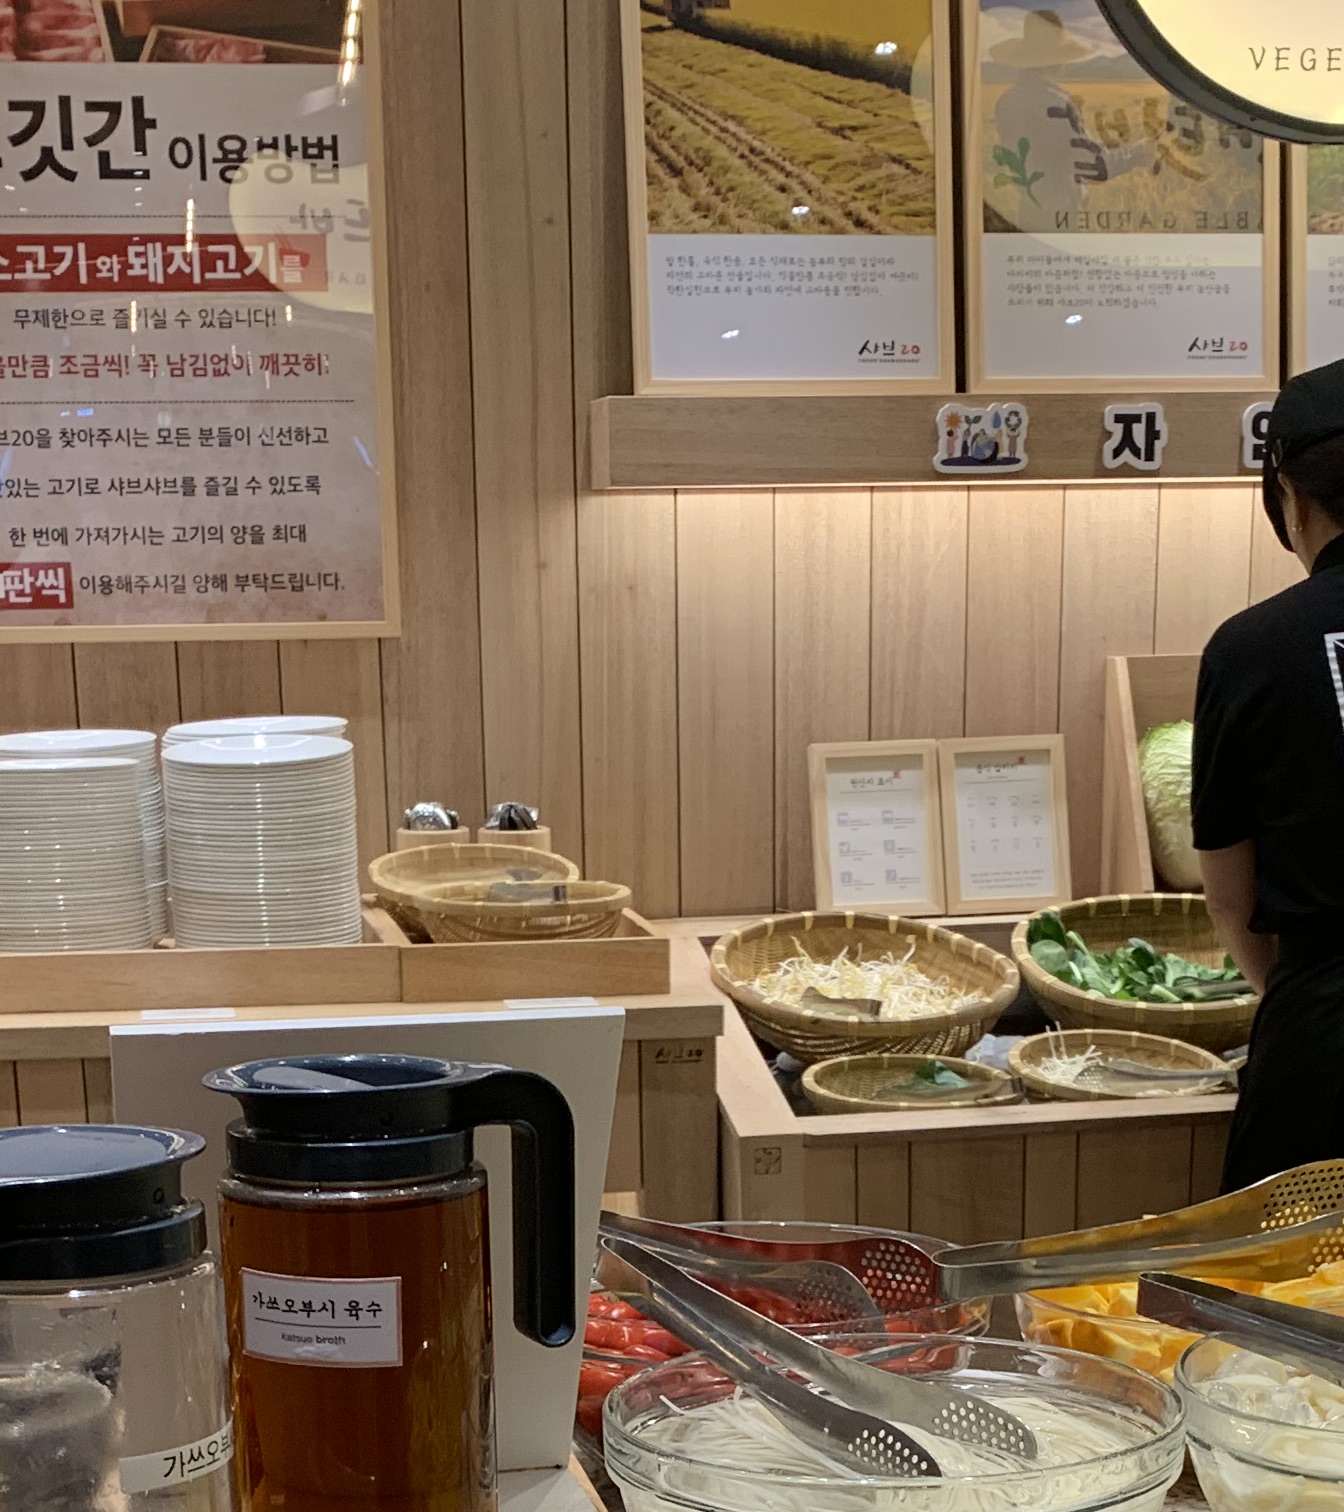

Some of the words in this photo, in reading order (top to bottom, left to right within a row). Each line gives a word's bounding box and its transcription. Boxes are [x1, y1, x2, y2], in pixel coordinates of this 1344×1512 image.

[167, 132, 342, 186] 이용방법
[126, 240, 307, 286] 돼지고기를
[12, 308, 107, 330] 무제한으로
[173, 309, 193, 330] 수
[198, 307, 277, 330] 있습니다!
[58, 354, 131, 380] 조금씩!
[137, 353, 159, 379] 꼭
[166, 352, 253, 378] 남김없이
[58, 428, 149, 450] 찾아주시는
[155, 427, 192, 449] 모든
[197, 426, 252, 449] 분들이
[257, 424, 330, 448] 신선하고
[46, 476, 101, 499] 고기로
[107, 476, 197, 499] 샤브샤브를
[203, 475, 239, 497] 즐길
[243, 475, 264, 497] 수
[268, 473, 323, 497] 있도록
[8, 526, 26, 549] 한
[32, 525, 69, 548] 번에
[74, 524, 165, 548] 가져가시는
[171, 523, 225, 546] 고기의
[230, 523, 266, 547] 양을
[271, 522, 308, 545] 최대
[78, 572, 188, 596] 이용해주시길
[192, 571, 228, 594] 양해
[234, 570, 346, 594] 부탁드립니다.
[252, 1291, 336, 1320] 가쓰오부시
[343, 1300, 383, 1321] 육수
[315, 1333, 347, 1346] broth
